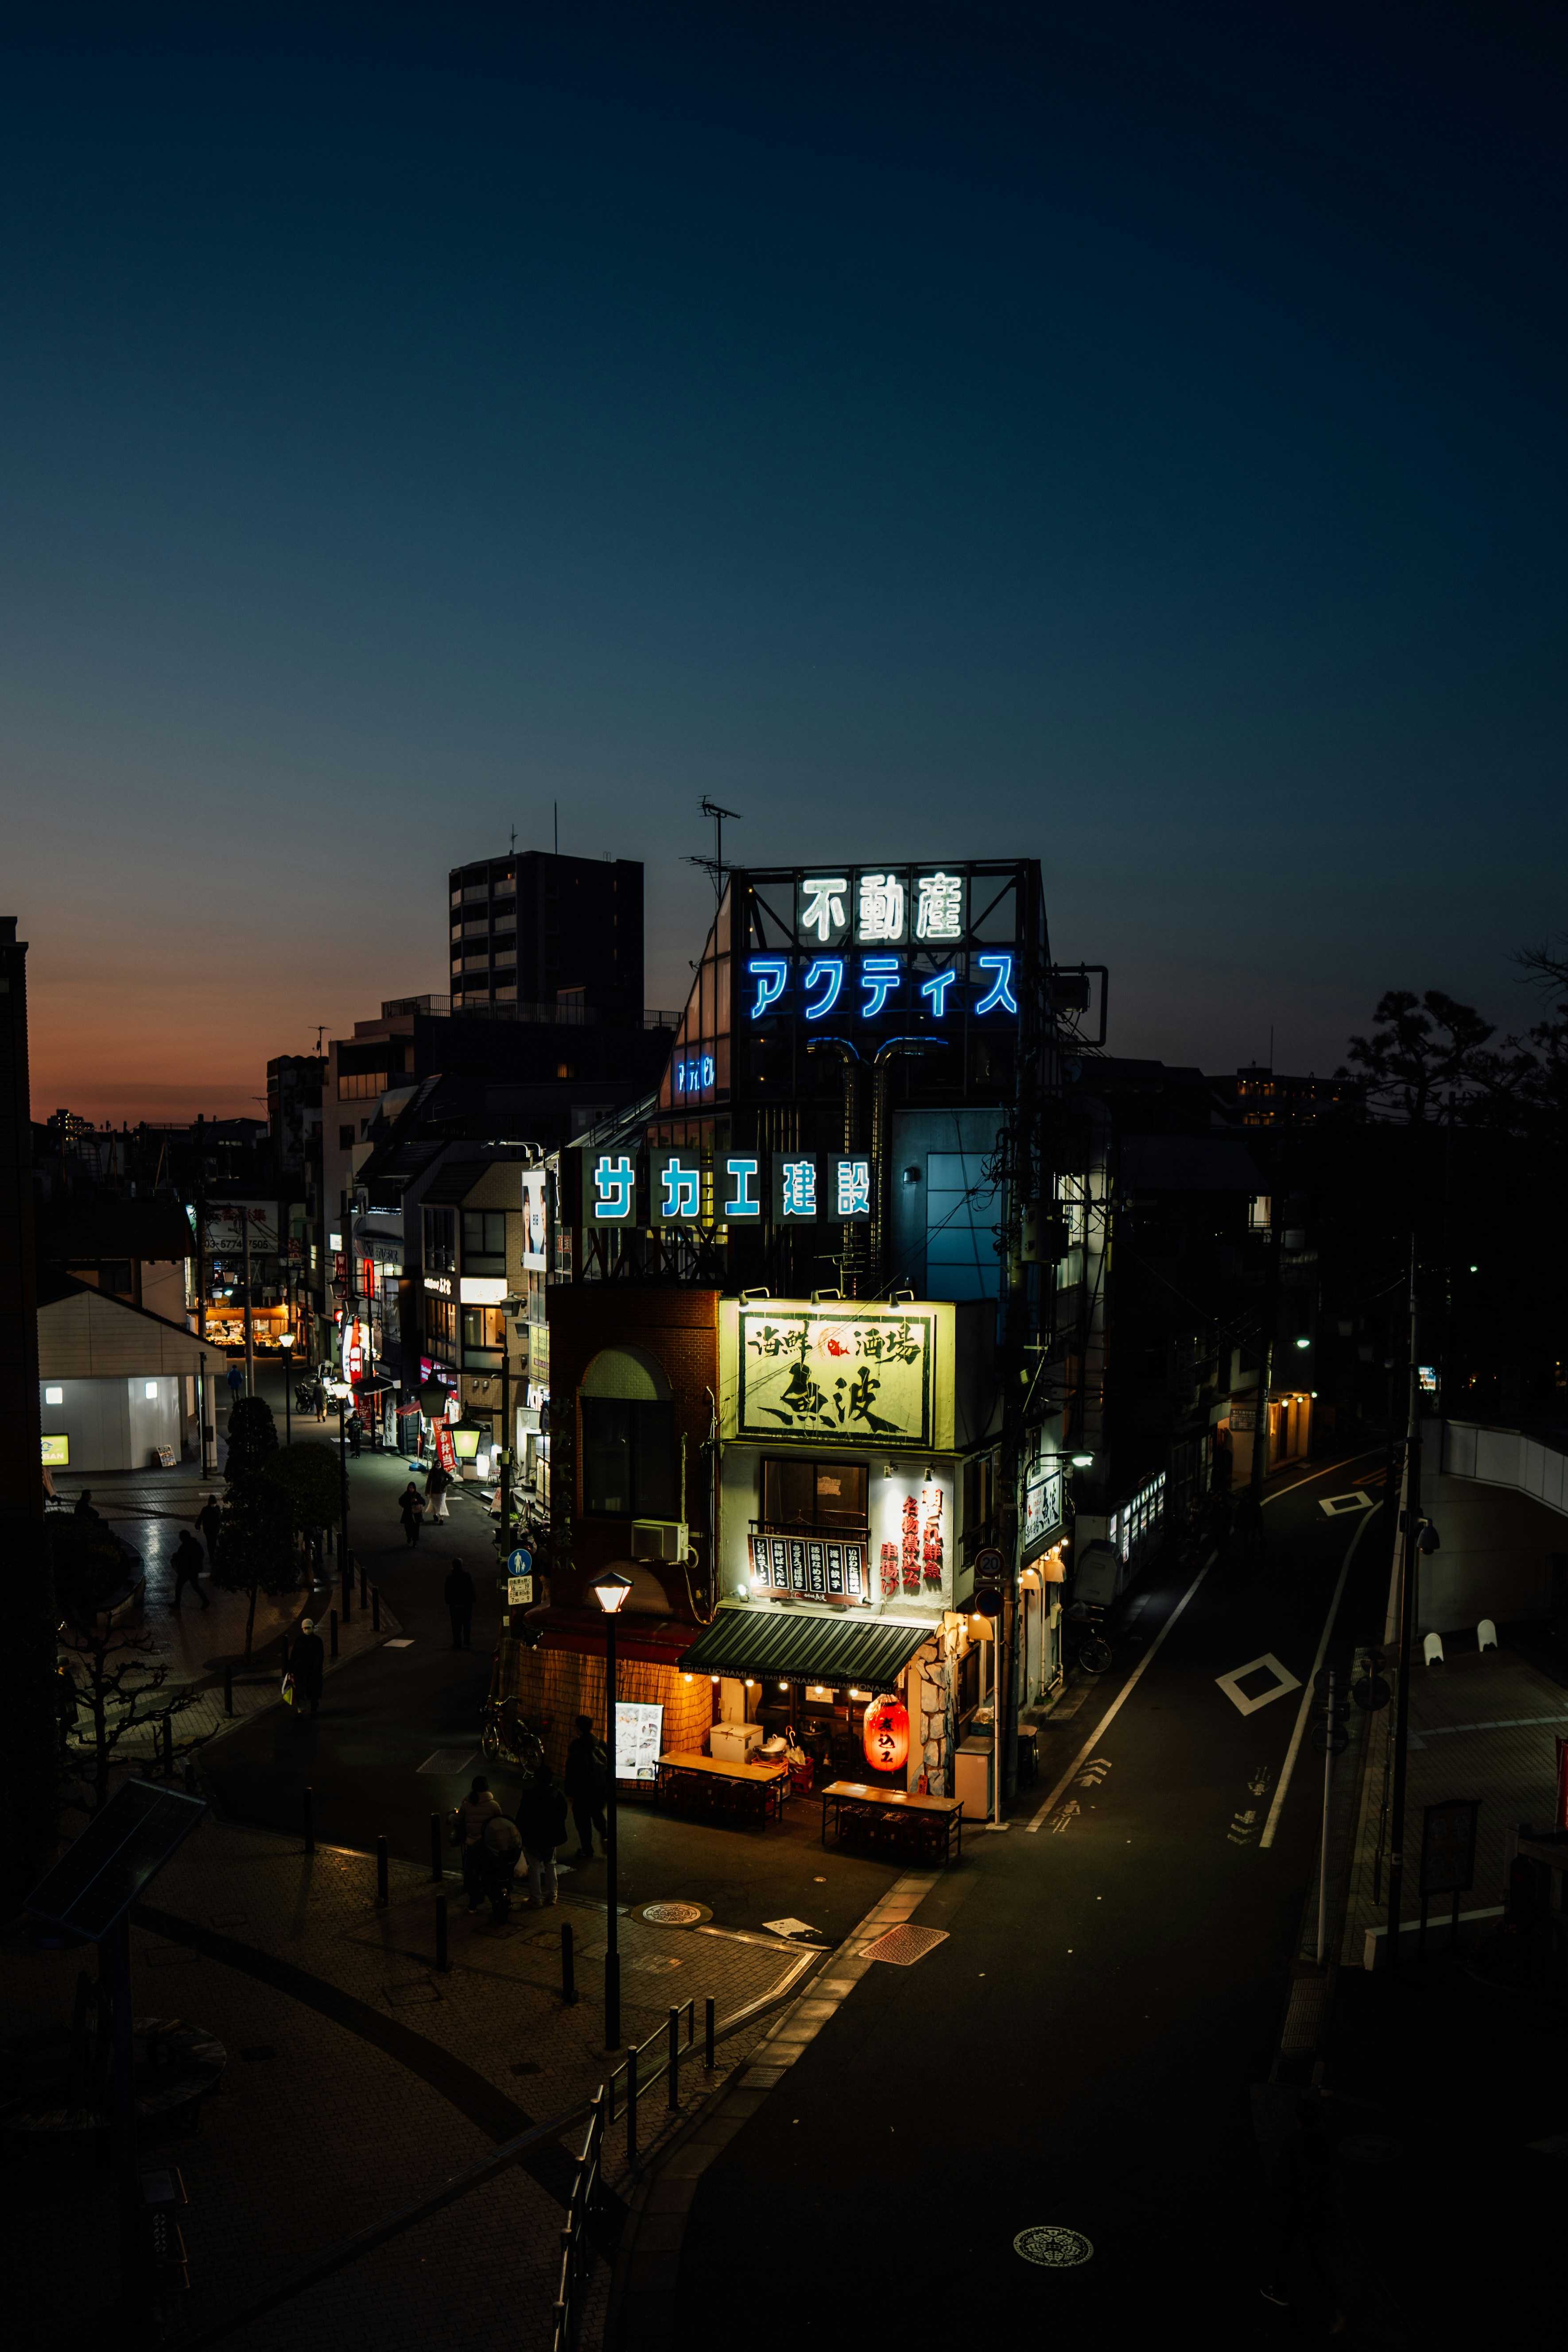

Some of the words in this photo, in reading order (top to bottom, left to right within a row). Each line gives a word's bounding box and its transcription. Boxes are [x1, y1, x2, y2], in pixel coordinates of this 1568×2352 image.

[802, 872, 962, 941] 不動産
[749, 955, 1017, 1020] アクティス
[595, 1157, 869, 1217] サカエ建設
[748, 1320, 812, 1367] 海鮮
[854, 1322, 921, 1365] 酒場
[757, 1362, 908, 1432] 魚波
[440, 1431, 453, 1466] お弁当
[552, 1397, 573, 1549] サカエ建設
[830, 1549, 840, 1588] 海老餃子
[880, 1542, 899, 1596] 串揚げ
[902, 1495, 921, 1587] 名物煮込み
[982, 1556, 998, 1569] 20
[709, 1668, 746, 1677] UONAMI
[779, 1675, 819, 1685] UONAMI
